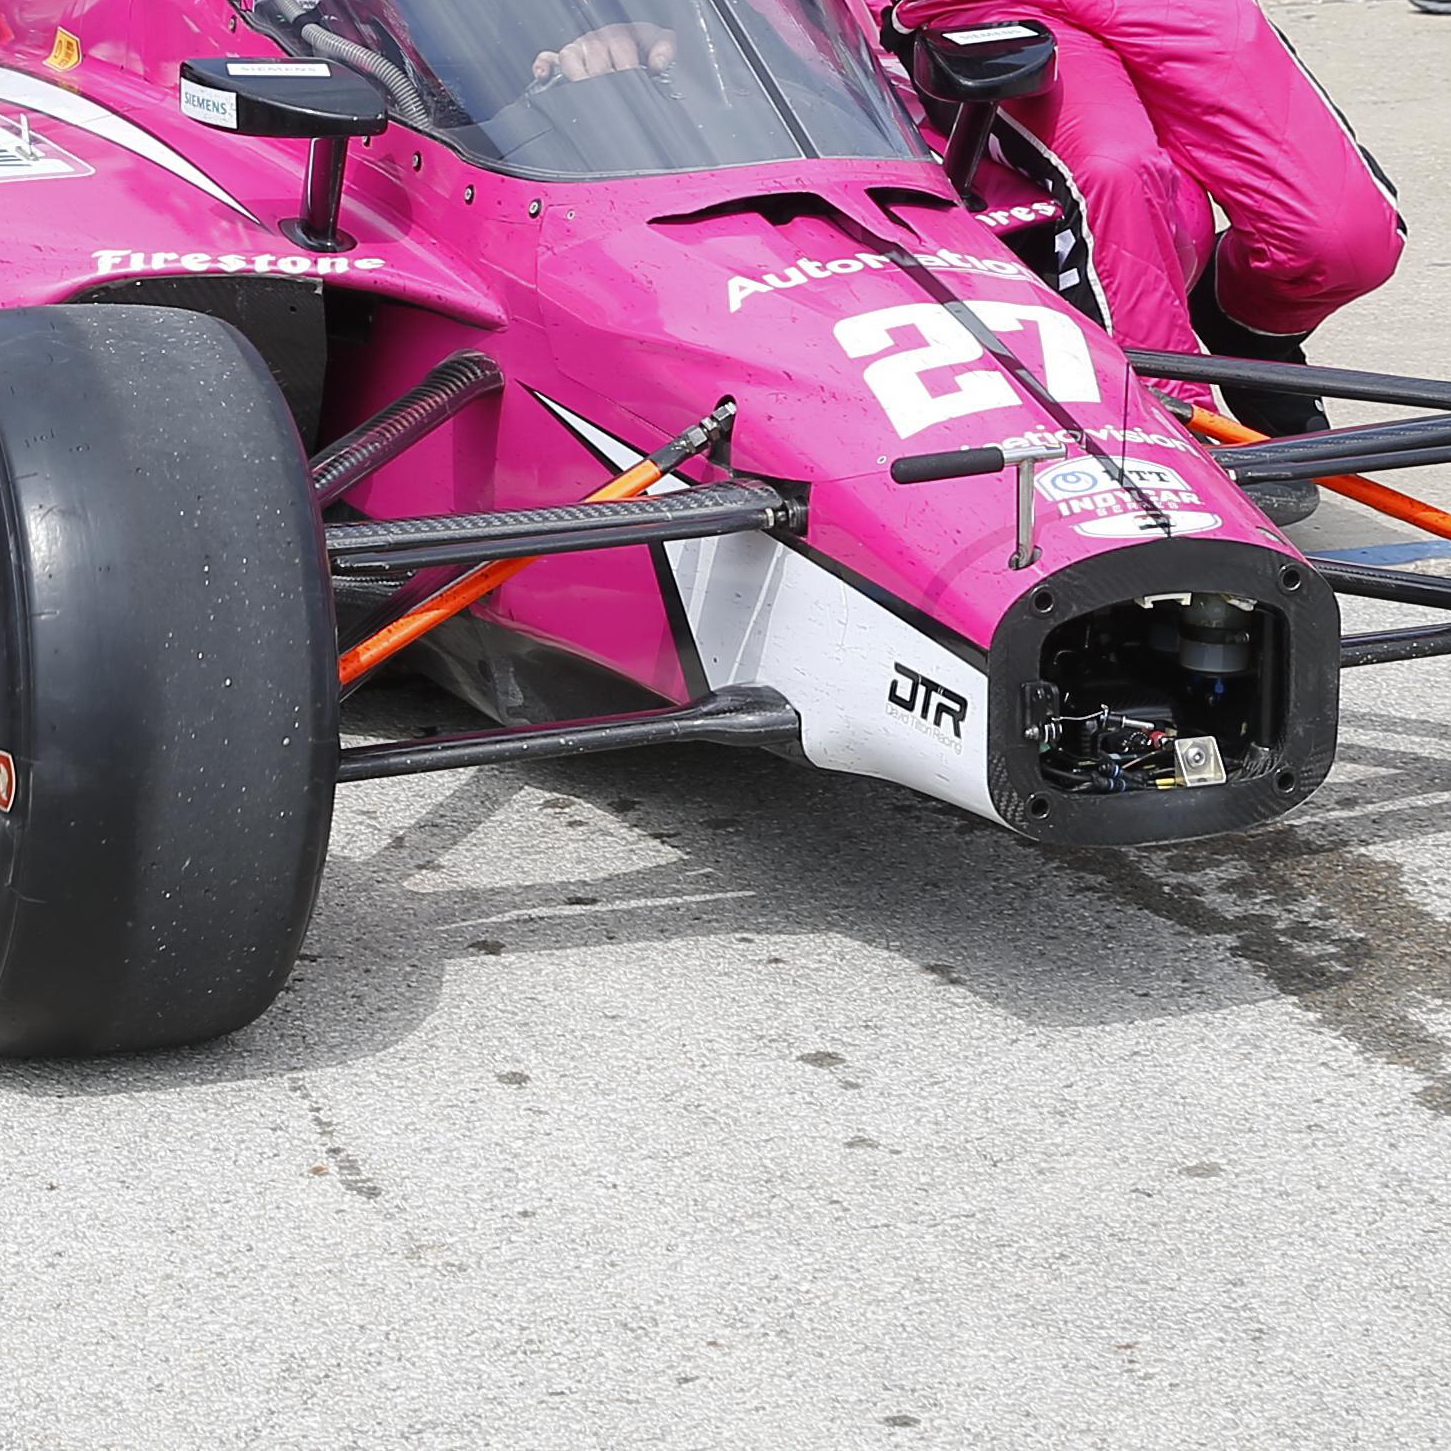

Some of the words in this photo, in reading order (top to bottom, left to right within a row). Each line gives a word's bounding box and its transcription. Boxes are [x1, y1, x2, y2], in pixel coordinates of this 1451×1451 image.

[184, 90, 228, 117] SIEMENS
[92, 248, 386, 275] Firestone
[833, 299, 1101, 440] 27
[1058, 489, 1202, 517] INDYCAR
[888, 661, 968, 740] DTR
